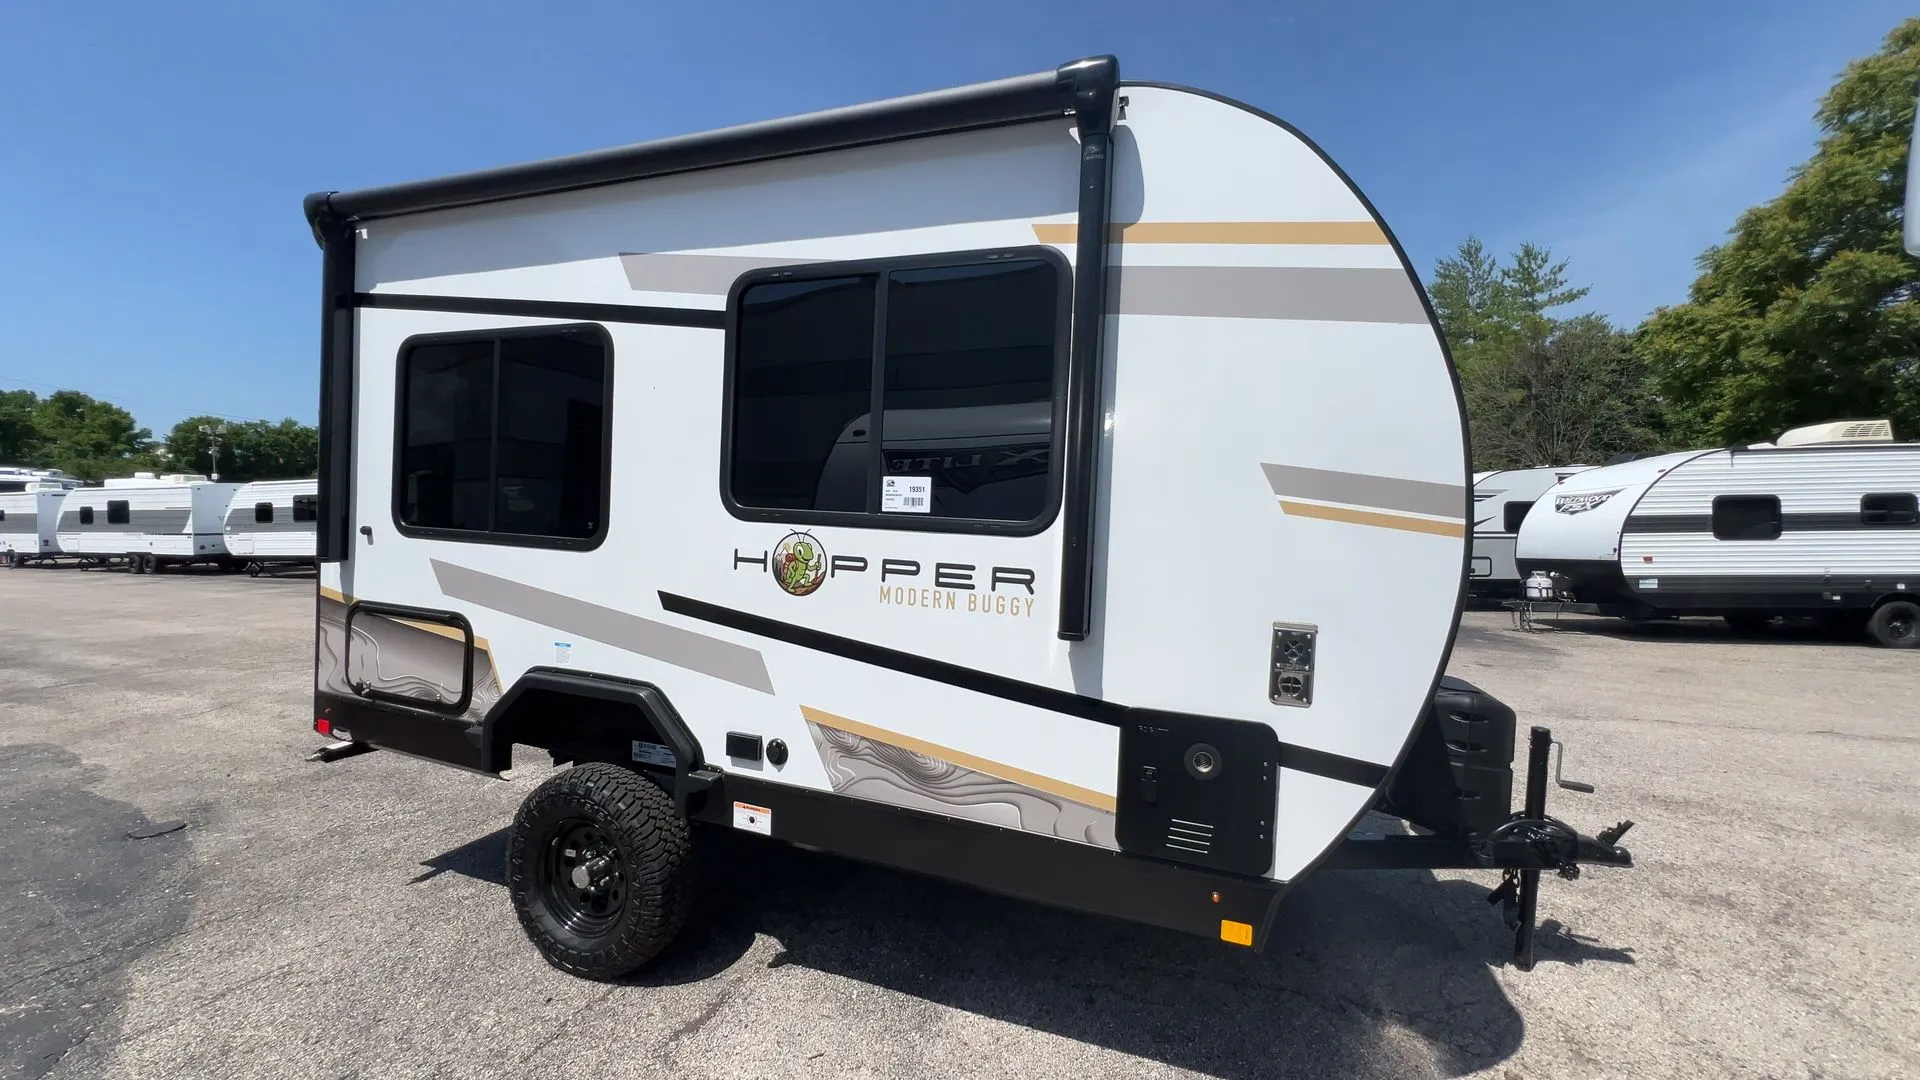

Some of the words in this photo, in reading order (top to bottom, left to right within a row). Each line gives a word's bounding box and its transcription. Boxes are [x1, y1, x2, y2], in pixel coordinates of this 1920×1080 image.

[909, 485, 926, 493] 19351
[733, 531, 1036, 597] HOPPER
[879, 585, 957, 611] MODERN
[967, 591, 1036, 618] BUGGY
